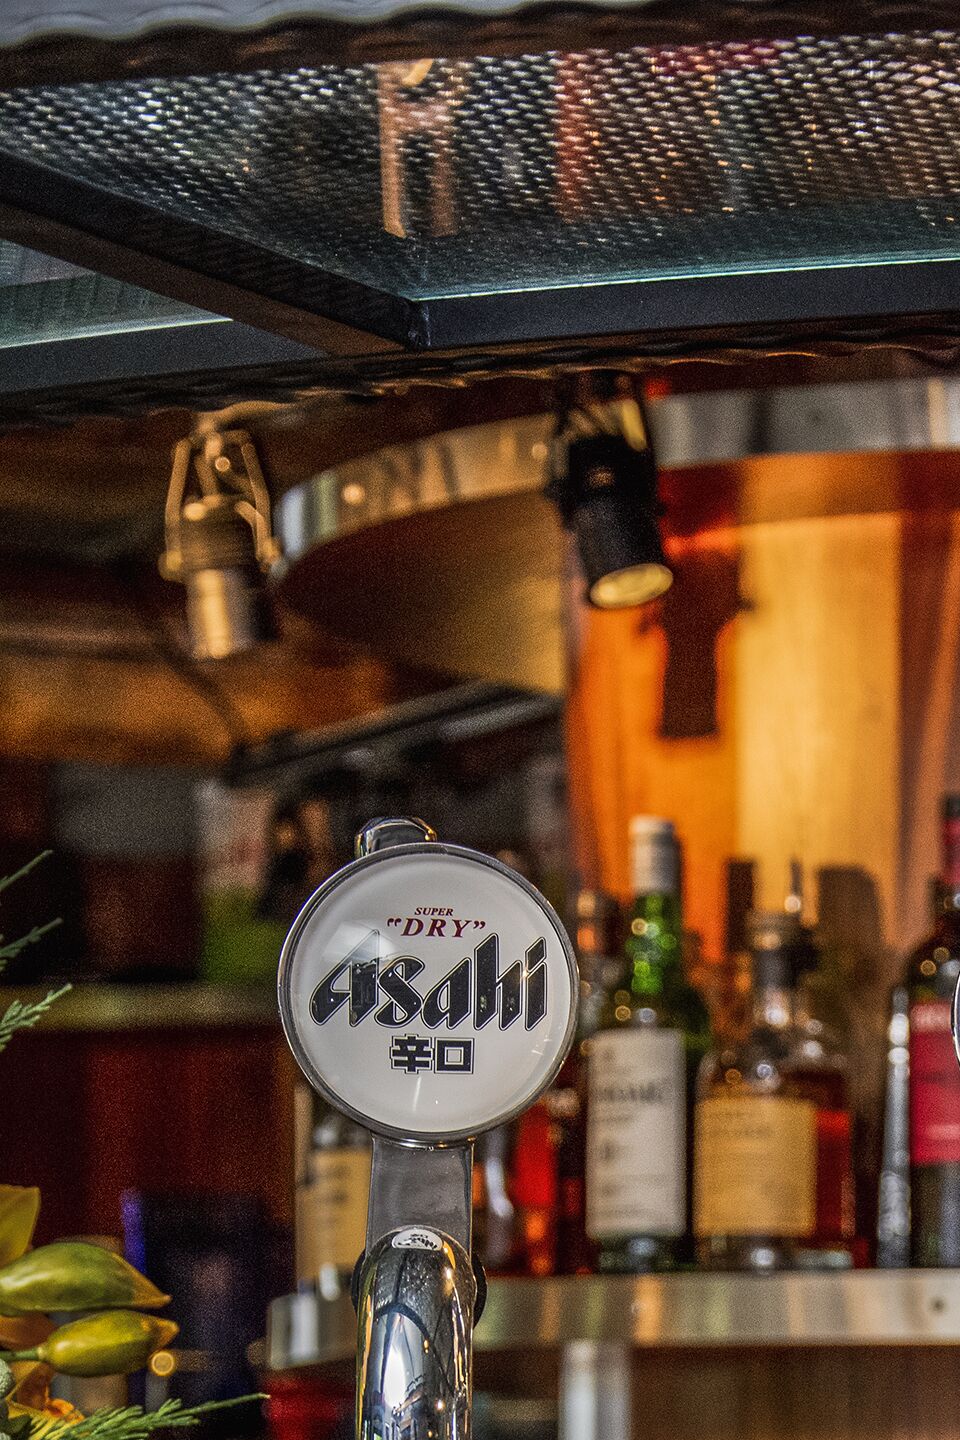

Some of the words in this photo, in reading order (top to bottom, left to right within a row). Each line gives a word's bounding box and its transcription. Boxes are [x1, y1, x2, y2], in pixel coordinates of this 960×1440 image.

[414, 906, 454, 917] SUPER
[309, 929, 547, 1031] Asahi
[389, 1033, 475, 1074] 辛口
